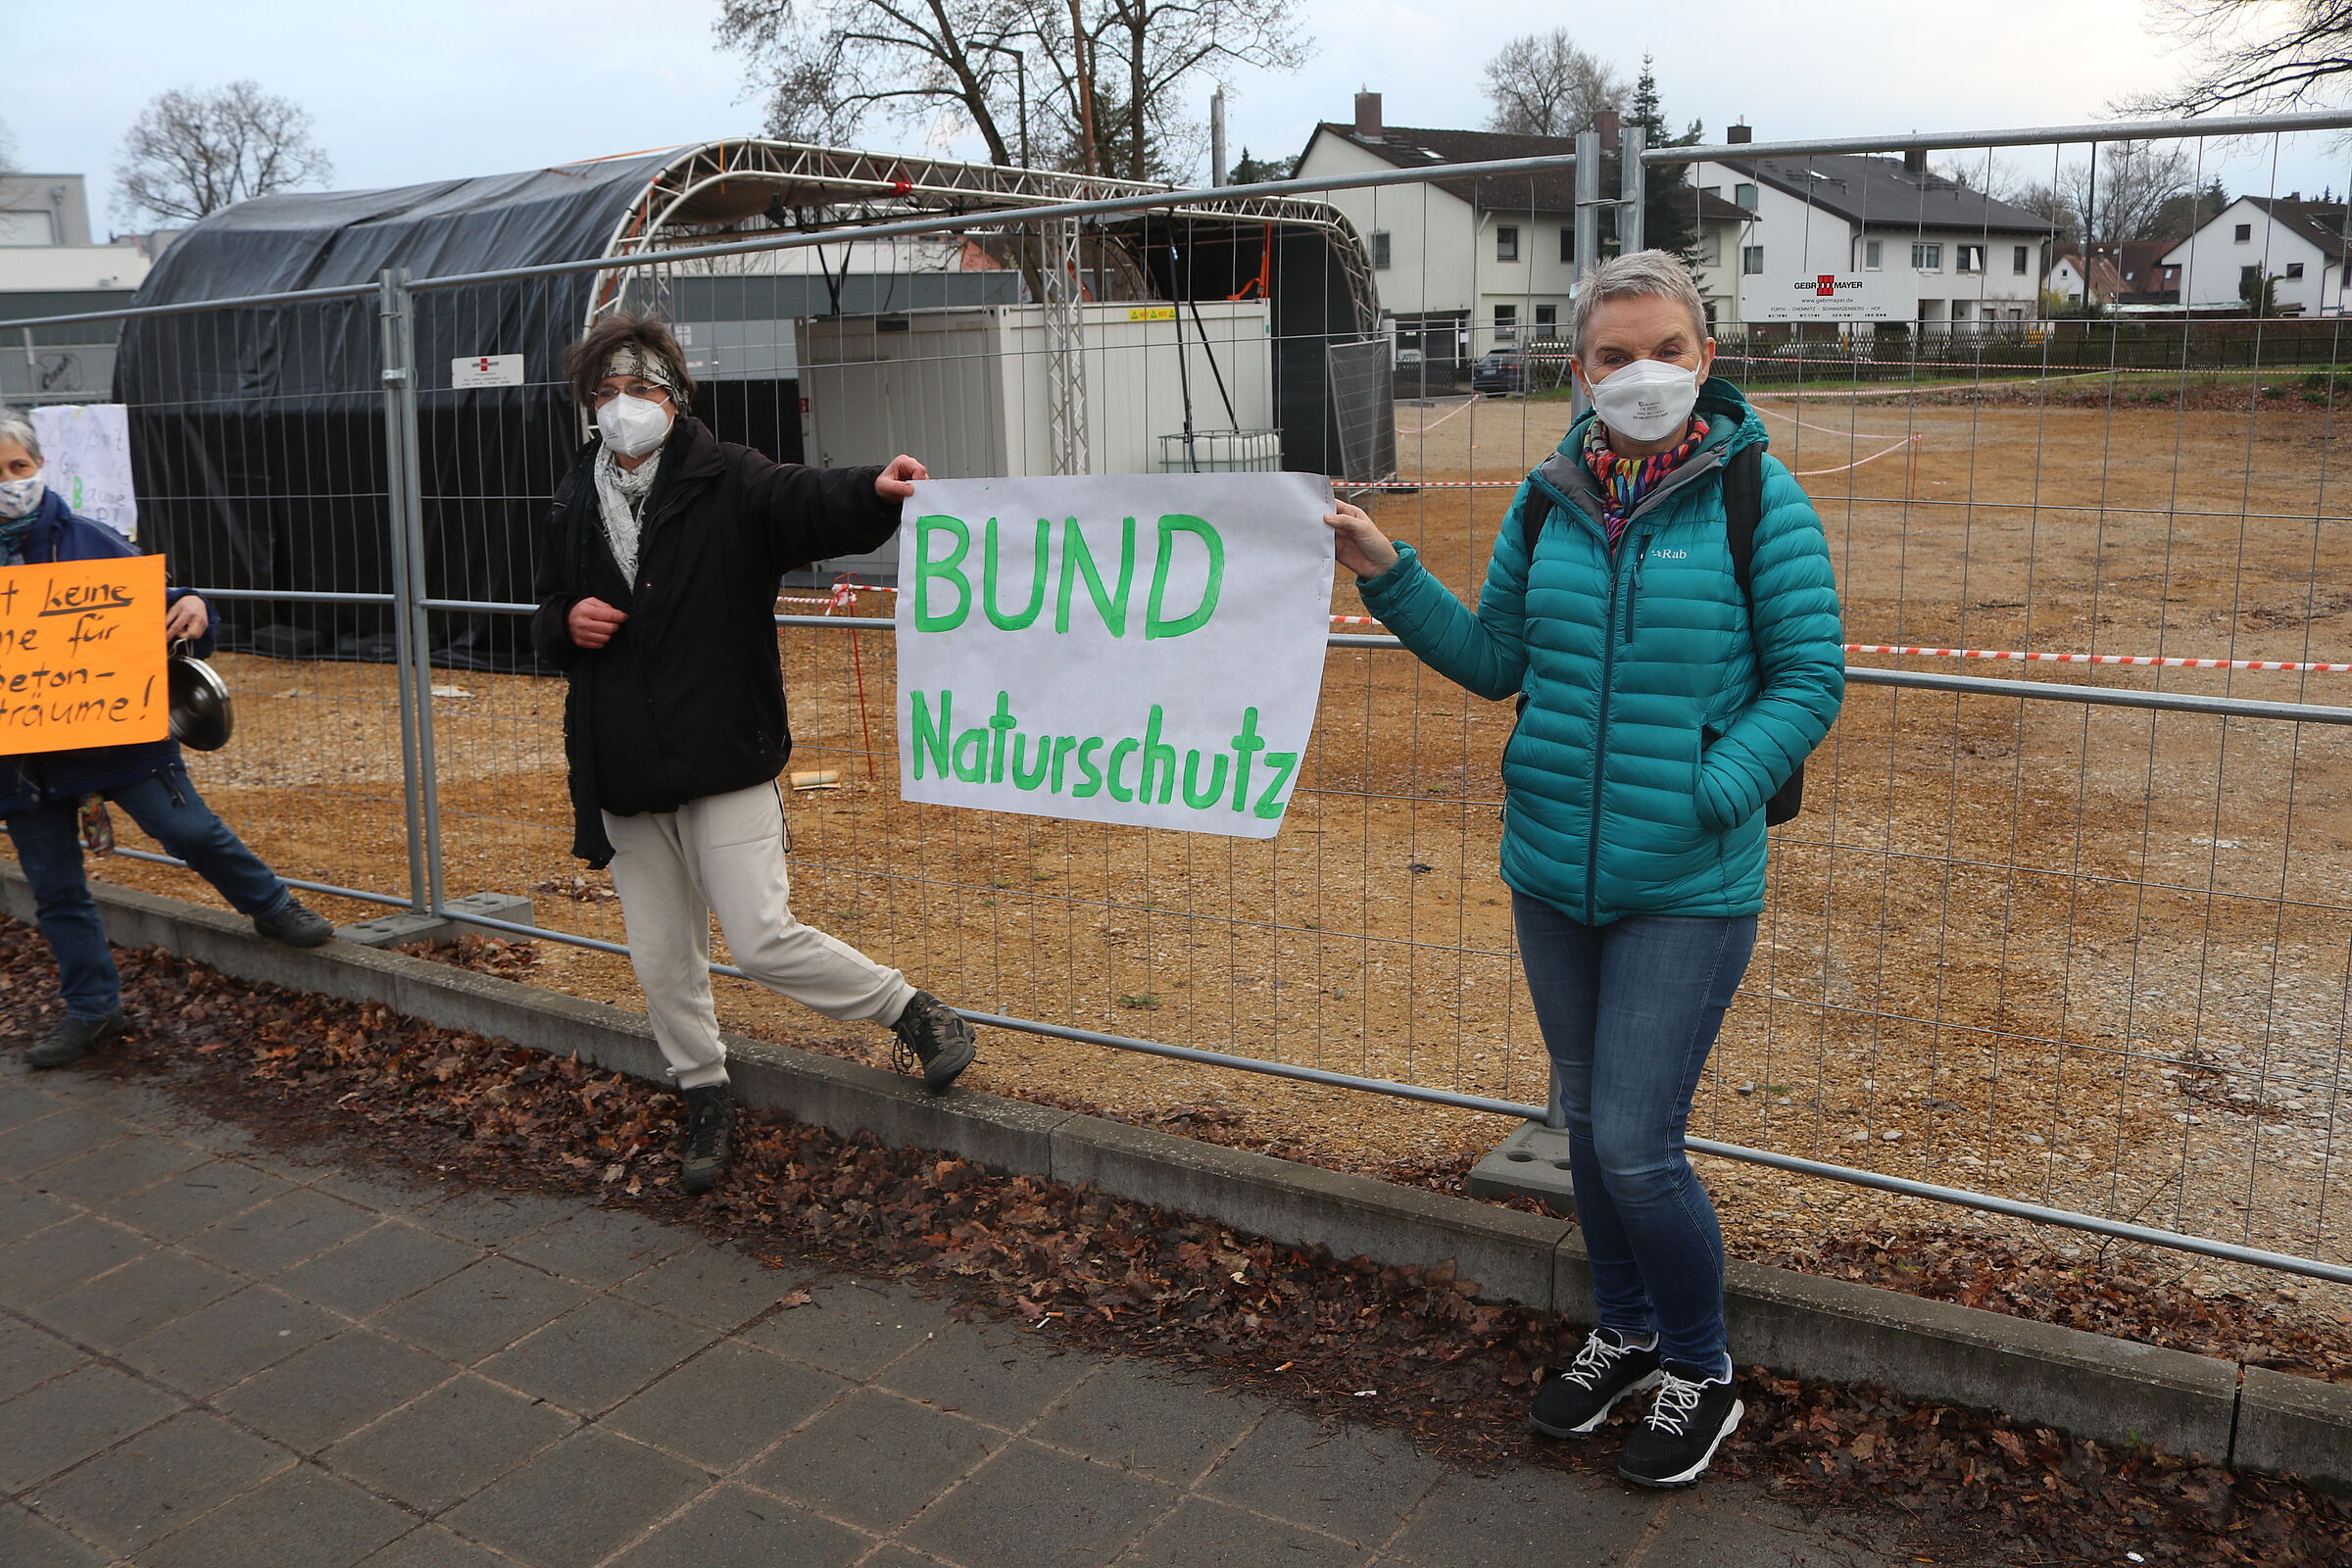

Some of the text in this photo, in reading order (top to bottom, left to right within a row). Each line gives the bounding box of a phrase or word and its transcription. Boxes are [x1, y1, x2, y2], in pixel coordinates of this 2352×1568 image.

[1793, 281, 1863, 290] GEBR MAYER
[1662, 549, 1687, 559] Rab
[42, 578, 135, 614] keine
[914, 514, 1225, 641] BUND
[67, 612, 121, 659] für
[910, 690, 1298, 819] Naturschutz
